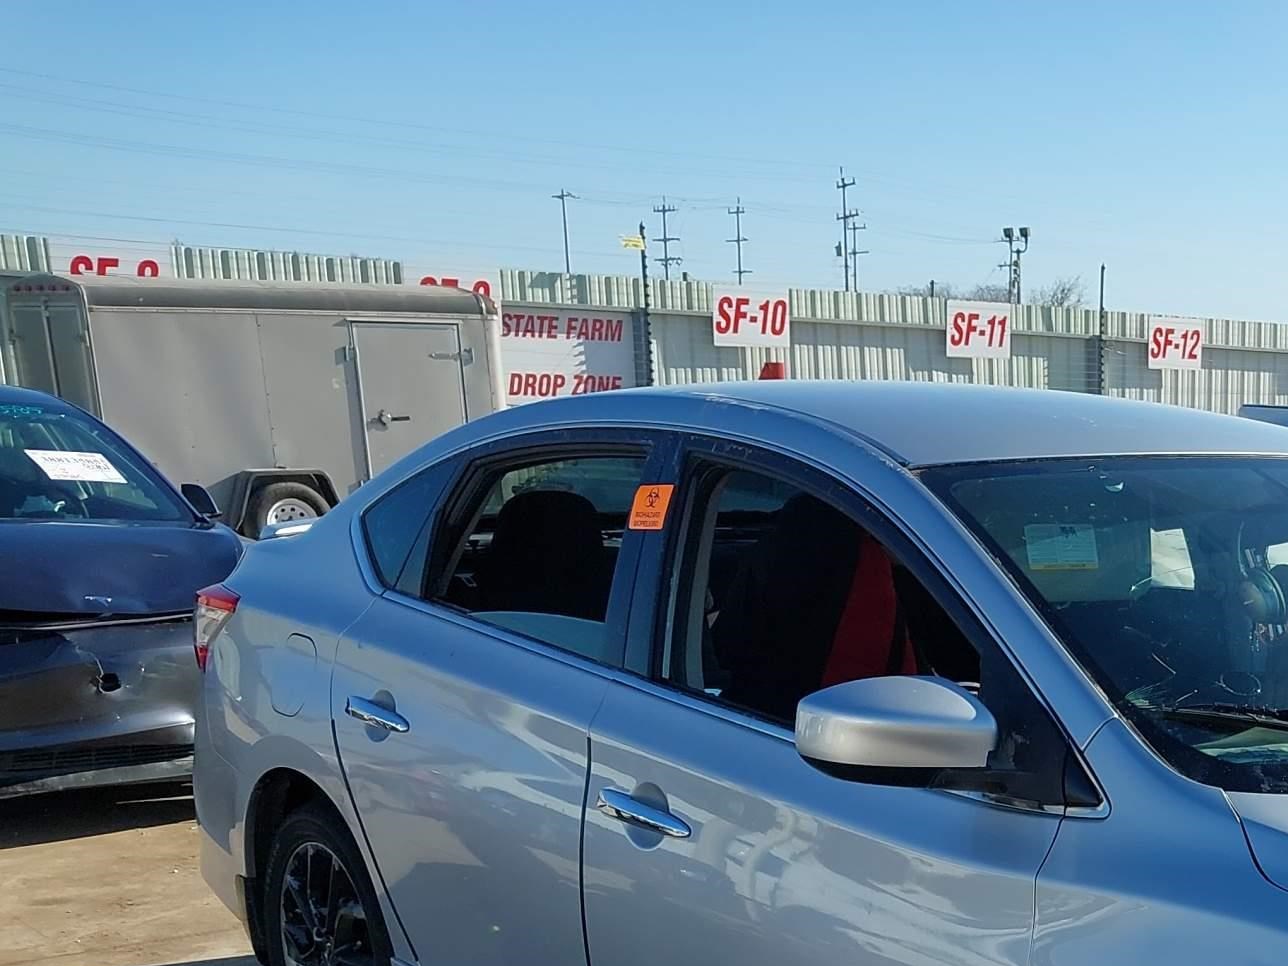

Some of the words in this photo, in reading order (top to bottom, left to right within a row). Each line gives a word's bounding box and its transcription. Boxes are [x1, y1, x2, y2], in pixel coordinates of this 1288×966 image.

[501, 313, 558, 339] STATE
[566, 317, 623, 342] FARM
[715, 296, 787, 336] SF-10
[950, 312, 1007, 347] SF-11
[1150, 326, 1201, 360] SF-12
[508, 372, 565, 396] DROP
